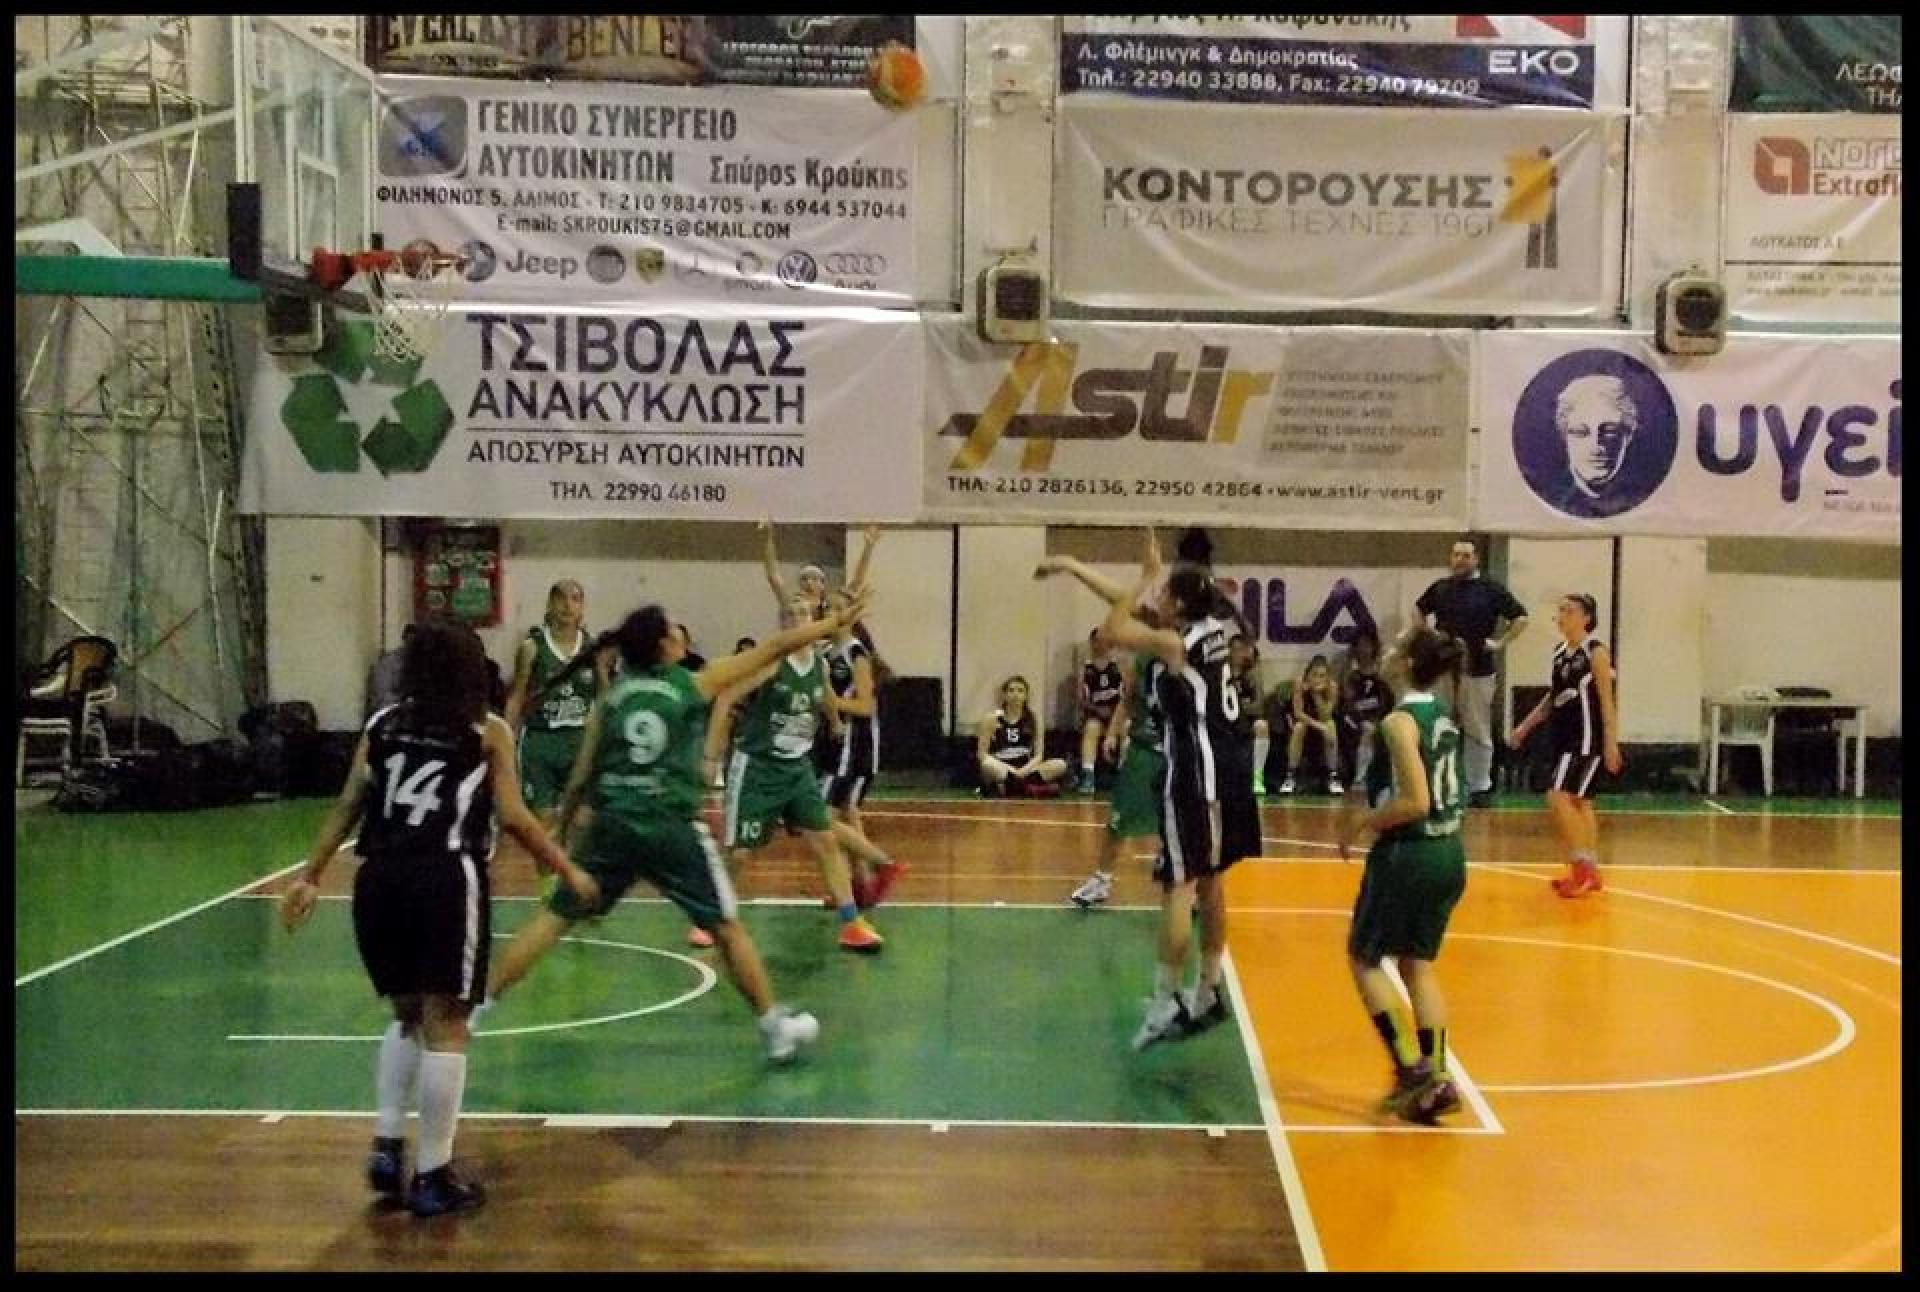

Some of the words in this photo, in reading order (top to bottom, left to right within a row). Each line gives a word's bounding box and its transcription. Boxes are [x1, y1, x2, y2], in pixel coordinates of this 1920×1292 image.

[1207, 44, 1223, 63] &
[1229, 45, 1359, 71] Δημοκρατίας
[1487, 48, 1580, 75] EKO
[1133, 69, 1201, 89] 22940
[1289, 73, 1332, 93] Fax:
[478, 101, 577, 136] ΓΕΝΙΚΟ
[587, 104, 738, 141] ΣΥΝΕΡΓΕΙΟ
[478, 144, 674, 183] ΑΥΤΟΚΙΝΗΤΩΝ
[709, 154, 797, 192] Σπύρος
[804, 156, 909, 194] Κρούκης
[377, 186, 483, 207] ΦΙΛΗΜΟΝΟΣ
[513, 190, 579, 209] ΑΛΙΜΟΣ
[620, 193, 655, 211] 210
[784, 199, 831, 216] 6944
[837, 200, 906, 219] 537044
[1103, 167, 1493, 208] ΚΟΝΤΟΡΟΥΣΗΣ
[1103, 204, 1265, 233] ΓΡΑΦΙΚΕΣ
[1285, 206, 1418, 236] ΤΕΧΝΕΣ
[505, 249, 579, 280] Jeep
[466, 313, 807, 378] ΤΣΙΒΟΛΑΣ
[467, 379, 806, 425] ΑΝΑΚΥΚΛΩΣΗ
[937, 341, 1277, 473] Astir
[468, 439, 609, 466] ΑΠΟΣΥΡΣΗ
[618, 441, 806, 468] ΑΥΤΟΚΙΝΗΤΩΝ
[603, 482, 662, 502] 22990
[667, 482, 726, 503] 46180
[996, 477, 1033, 494] 210
[1216, 577, 1379, 644] ILA
[623, 710, 668, 764] 9
[383, 752, 447, 826] 14
